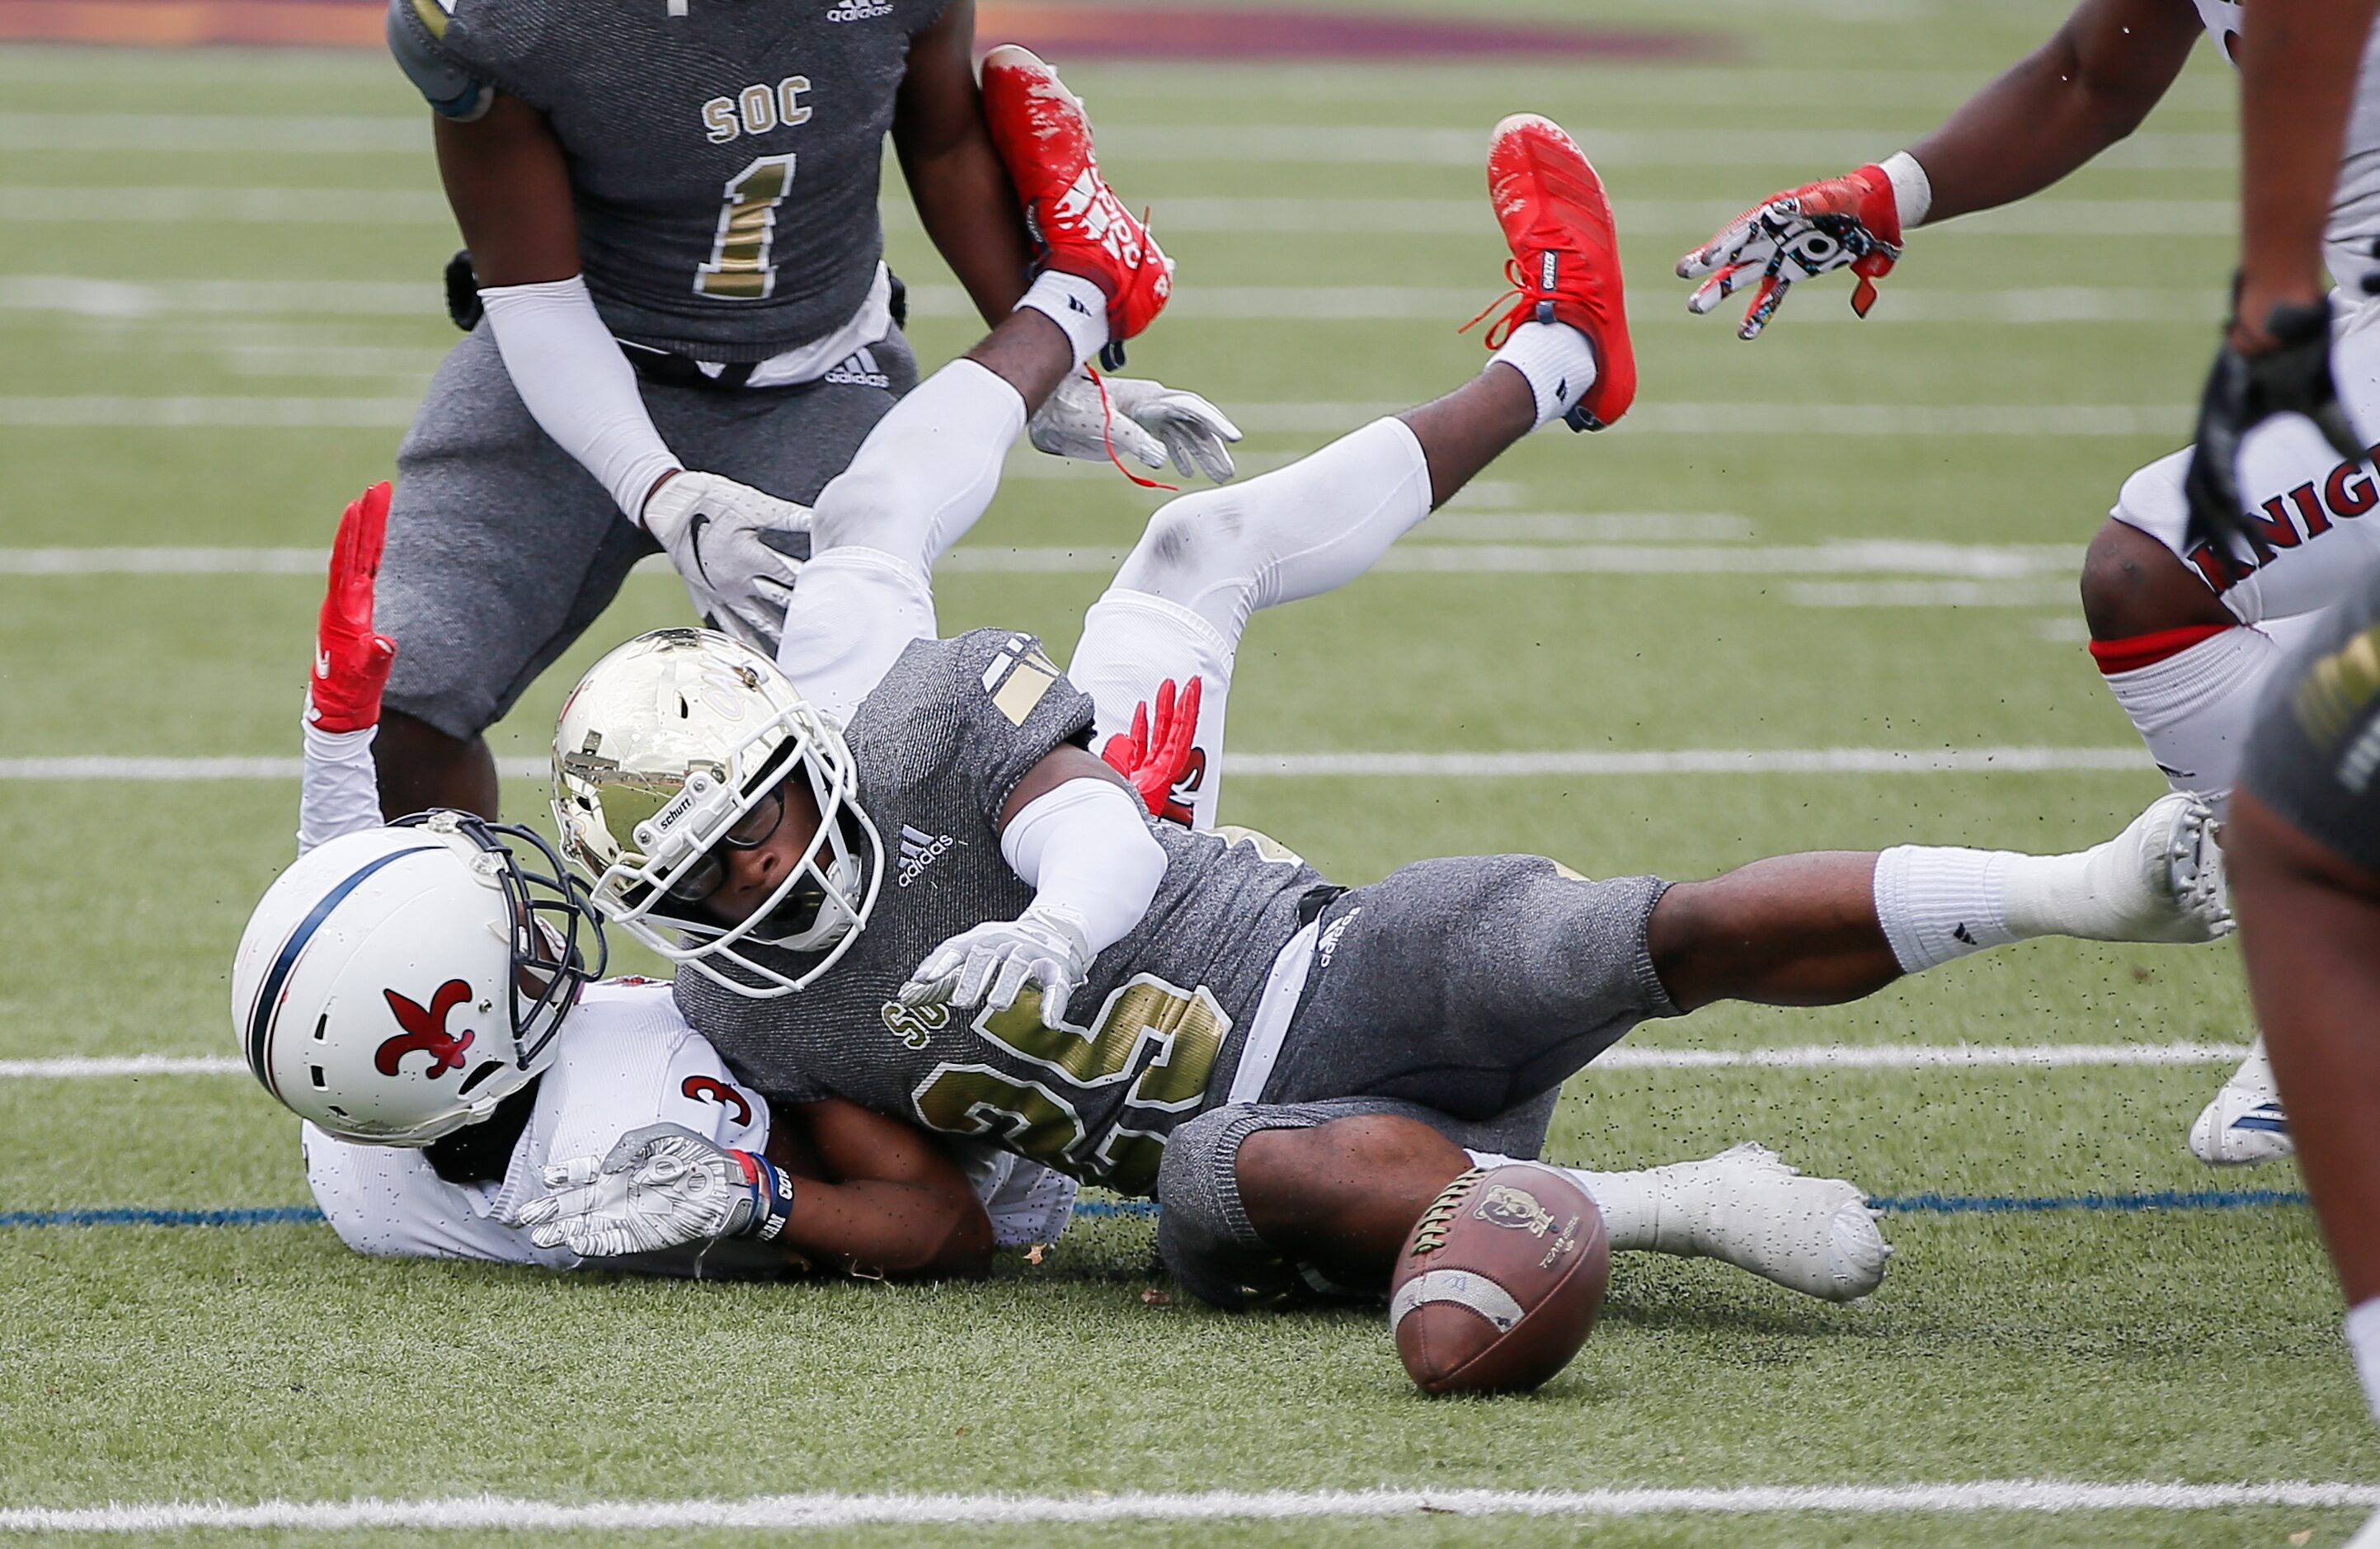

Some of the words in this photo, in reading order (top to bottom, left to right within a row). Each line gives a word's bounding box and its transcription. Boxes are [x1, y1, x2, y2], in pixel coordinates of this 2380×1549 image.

[826, 4, 894, 22] adidas
[702, 75, 813, 144] SOC
[692, 153, 797, 300] 1
[825, 373, 890, 388] adidas
[898, 835, 953, 887] adidas
[1320, 906, 1362, 968] adidas
[881, 1000, 951, 1051] SO
[681, 1075, 752, 1128] 3
